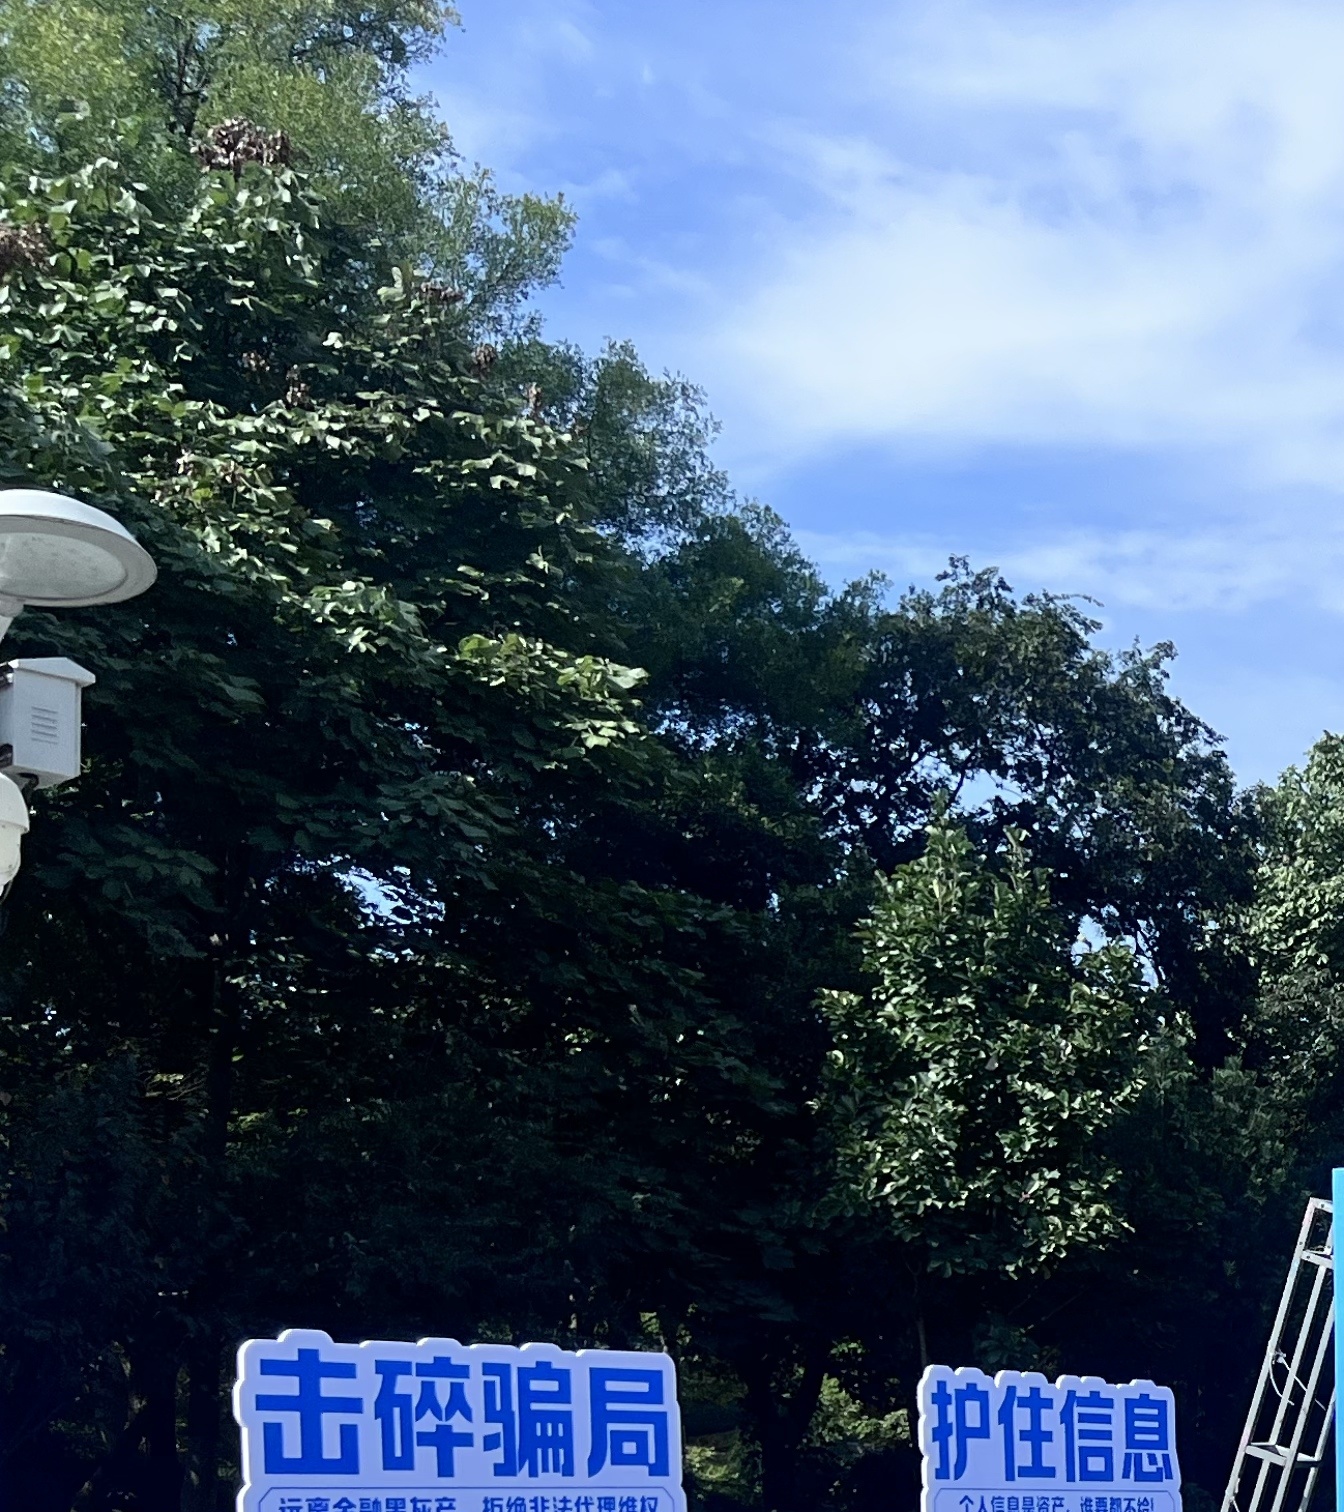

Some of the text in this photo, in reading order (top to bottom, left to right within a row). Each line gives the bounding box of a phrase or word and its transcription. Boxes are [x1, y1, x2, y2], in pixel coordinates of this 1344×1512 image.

[256, 1347, 671, 1478] 击碎骗局
[930, 1379, 1175, 1483] 护住信息
